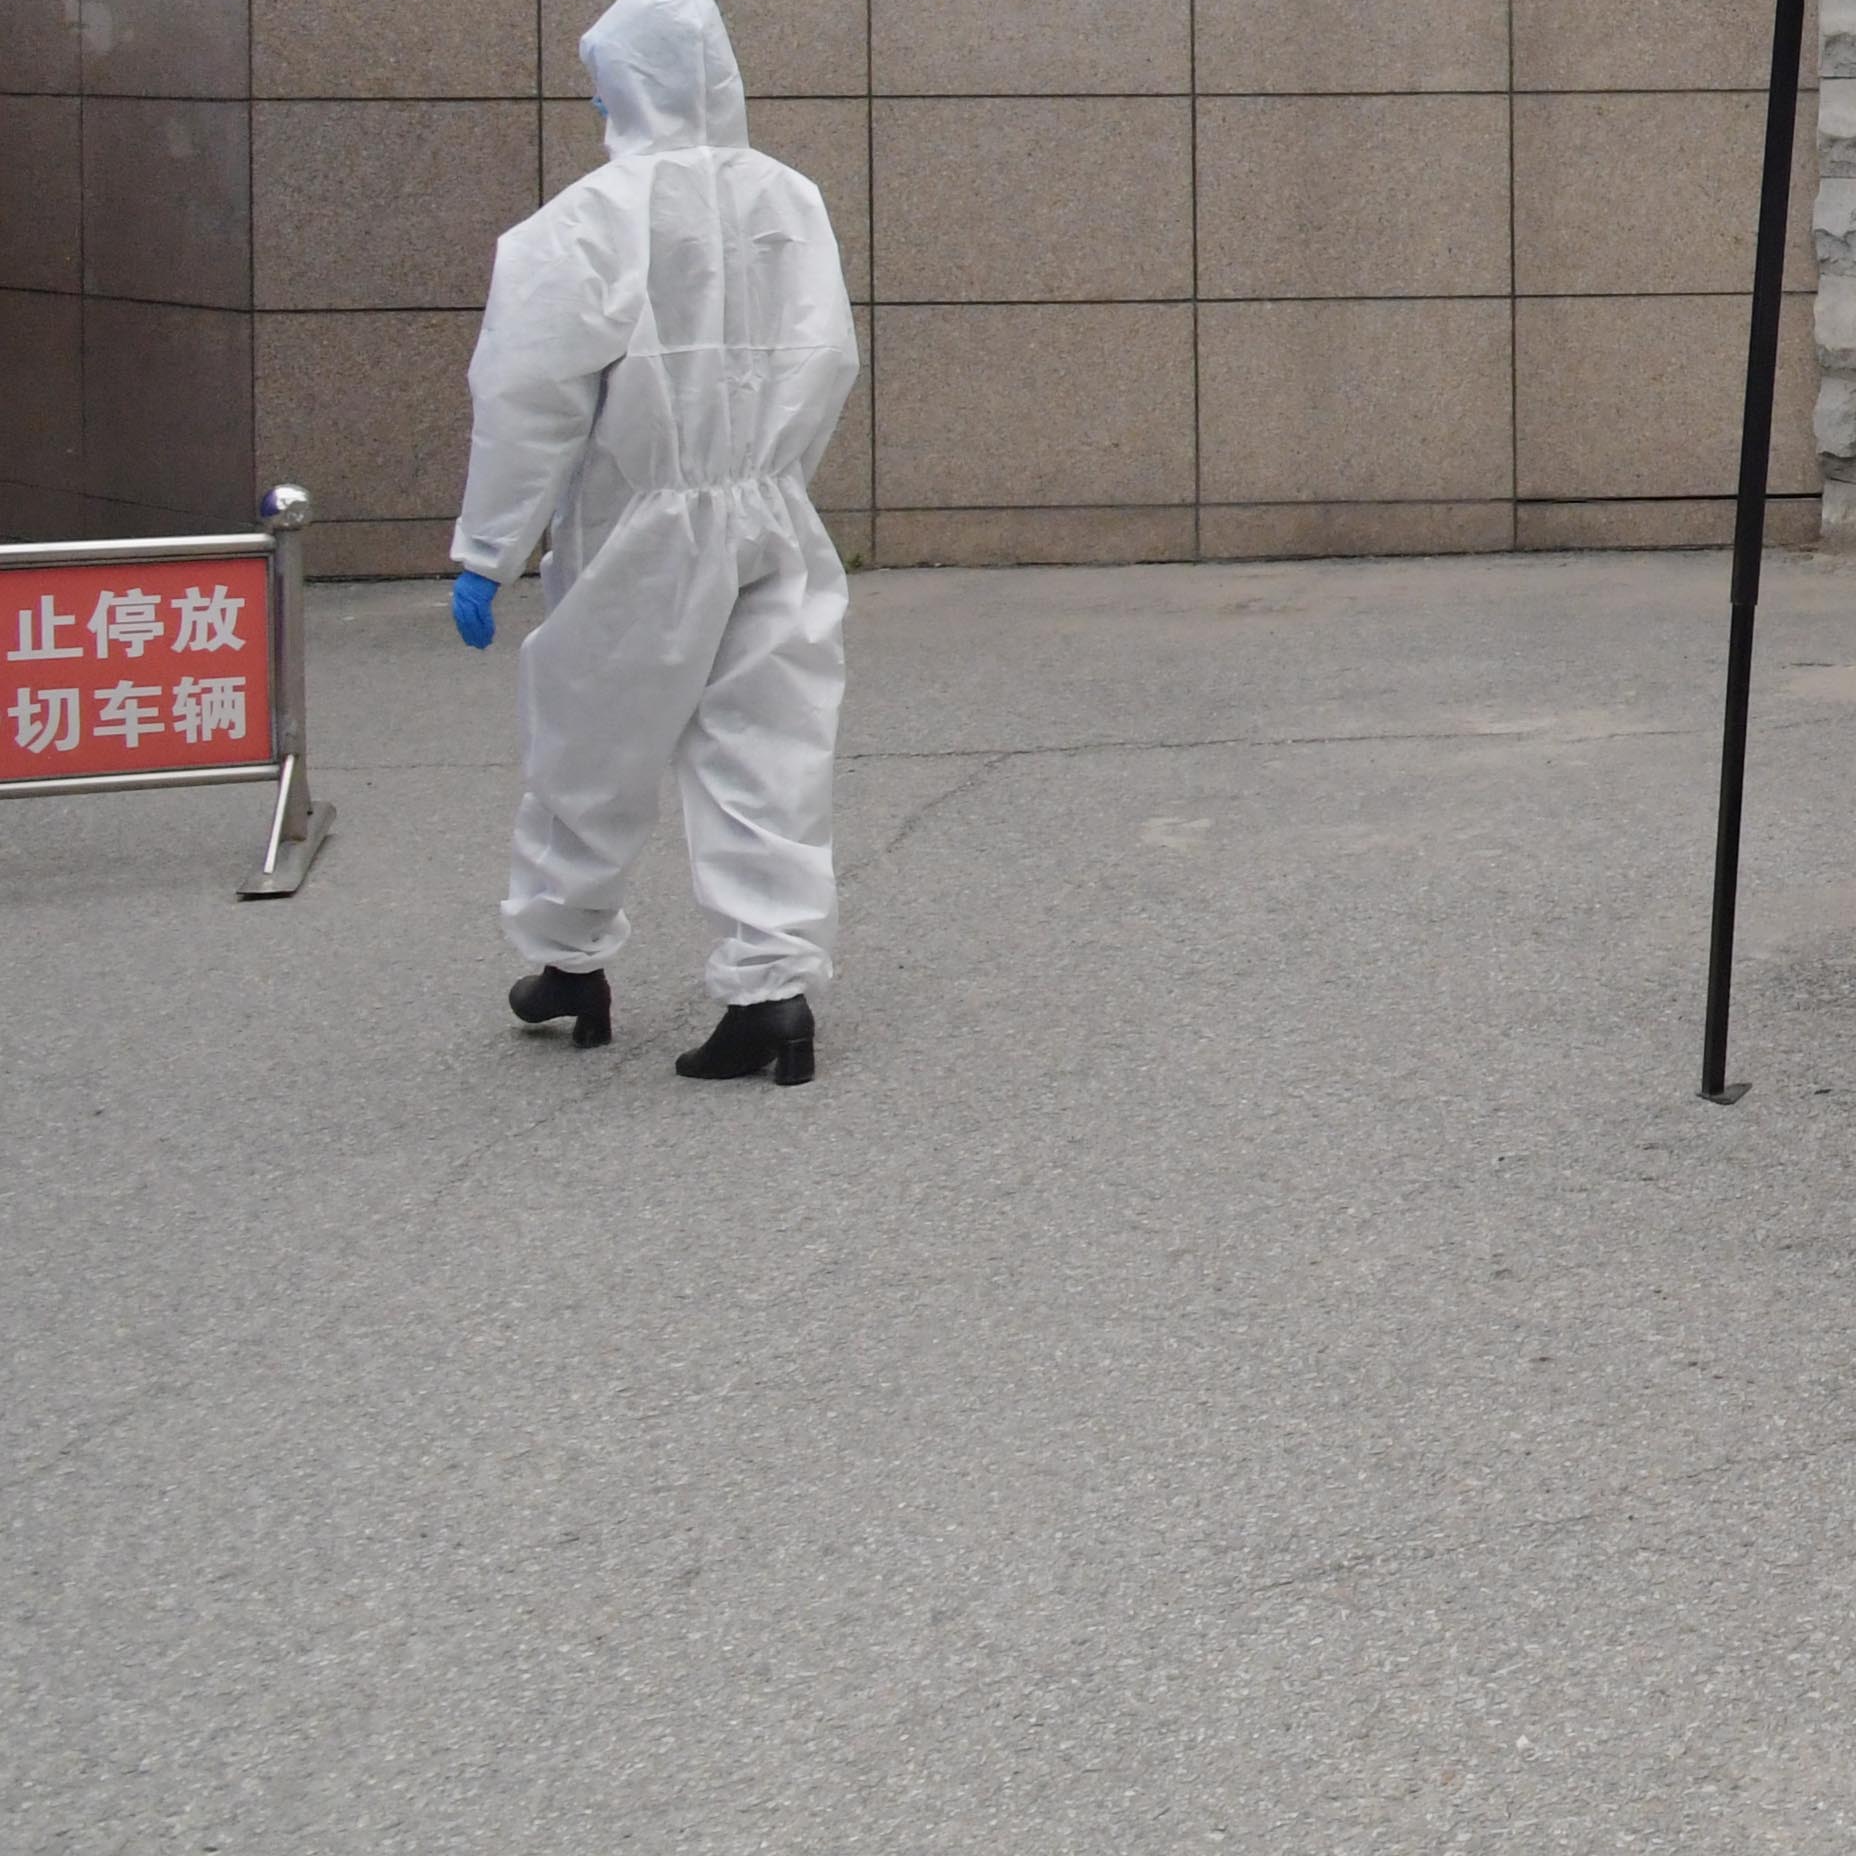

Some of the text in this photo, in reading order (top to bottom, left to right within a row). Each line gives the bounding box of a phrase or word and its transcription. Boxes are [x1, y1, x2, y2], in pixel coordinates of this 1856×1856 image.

[7, 585, 247, 661] 止停放
[7, 676, 247, 754] 切车辆
